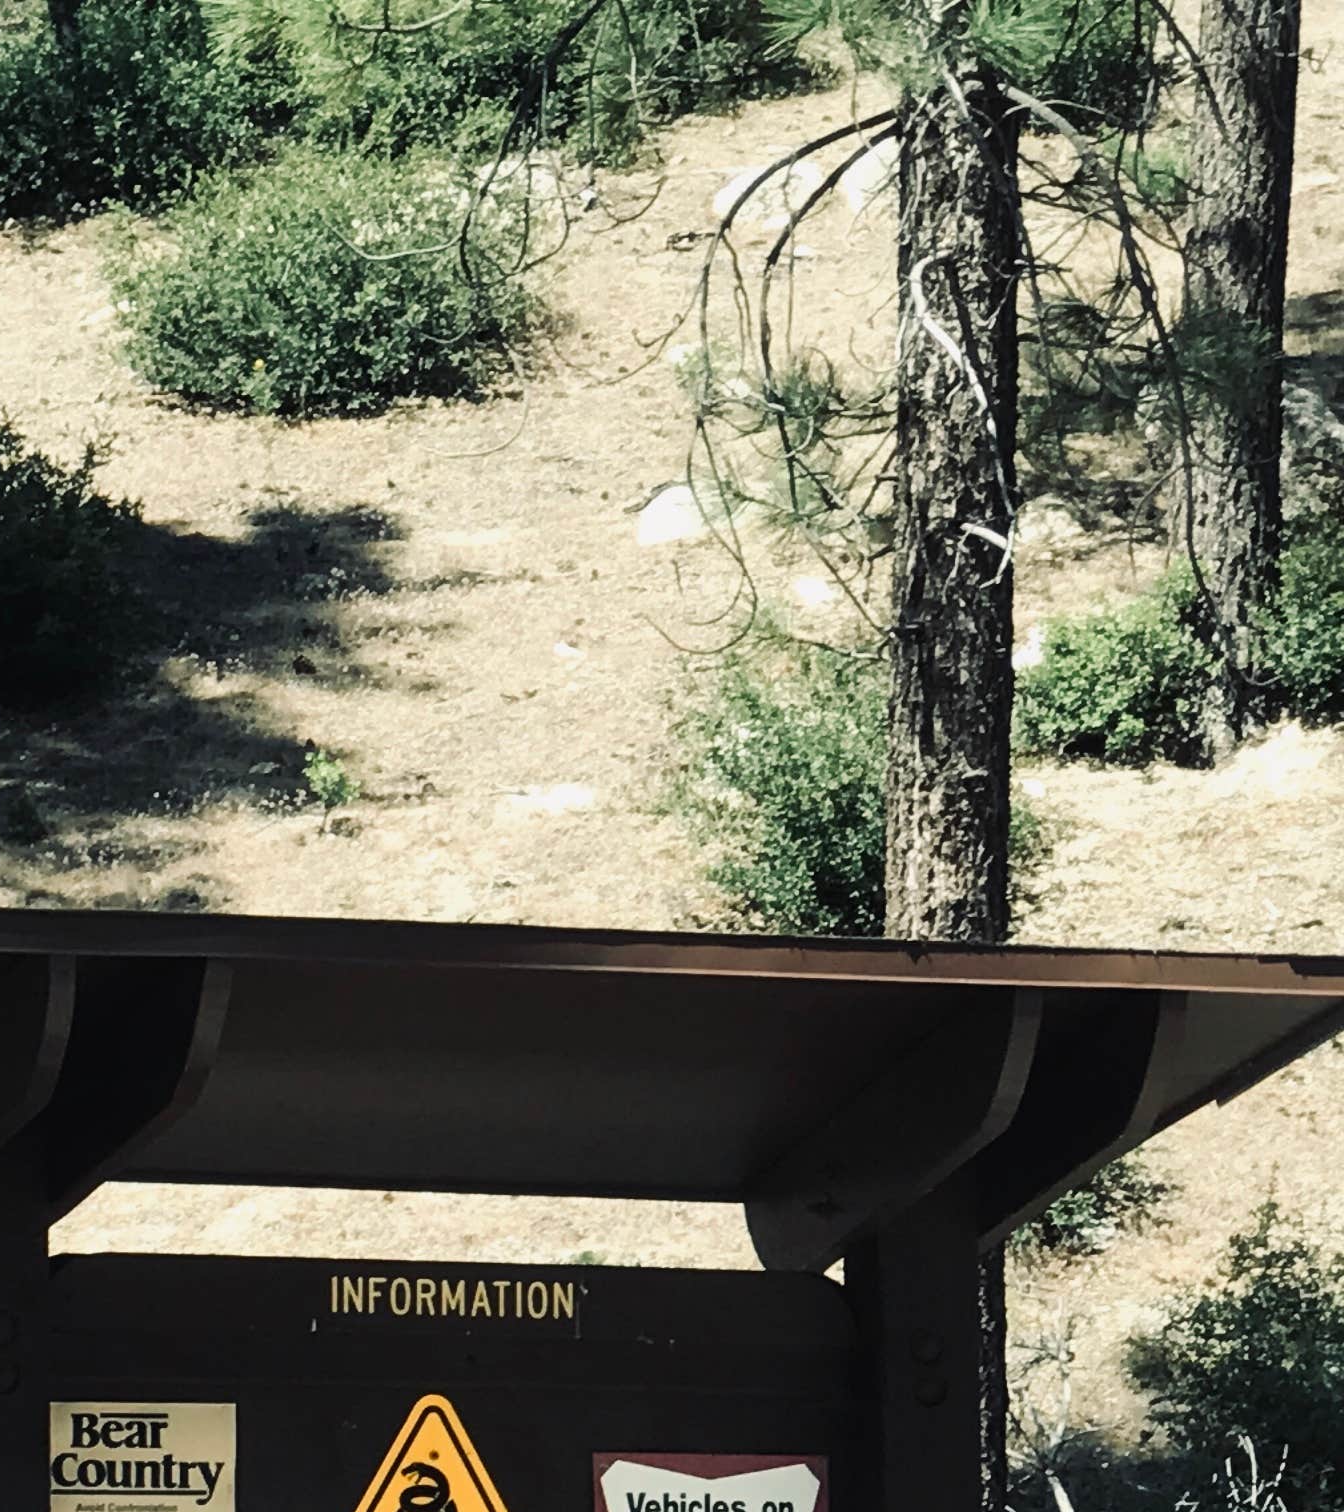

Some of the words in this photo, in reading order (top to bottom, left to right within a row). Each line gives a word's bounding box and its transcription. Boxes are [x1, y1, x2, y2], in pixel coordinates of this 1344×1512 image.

[331, 1276, 573, 1319] INFORMATION
[71, 1413, 168, 1448] Bear
[52, 1453, 224, 1505] Country
[76, 1504, 105, 1512] Avoid
